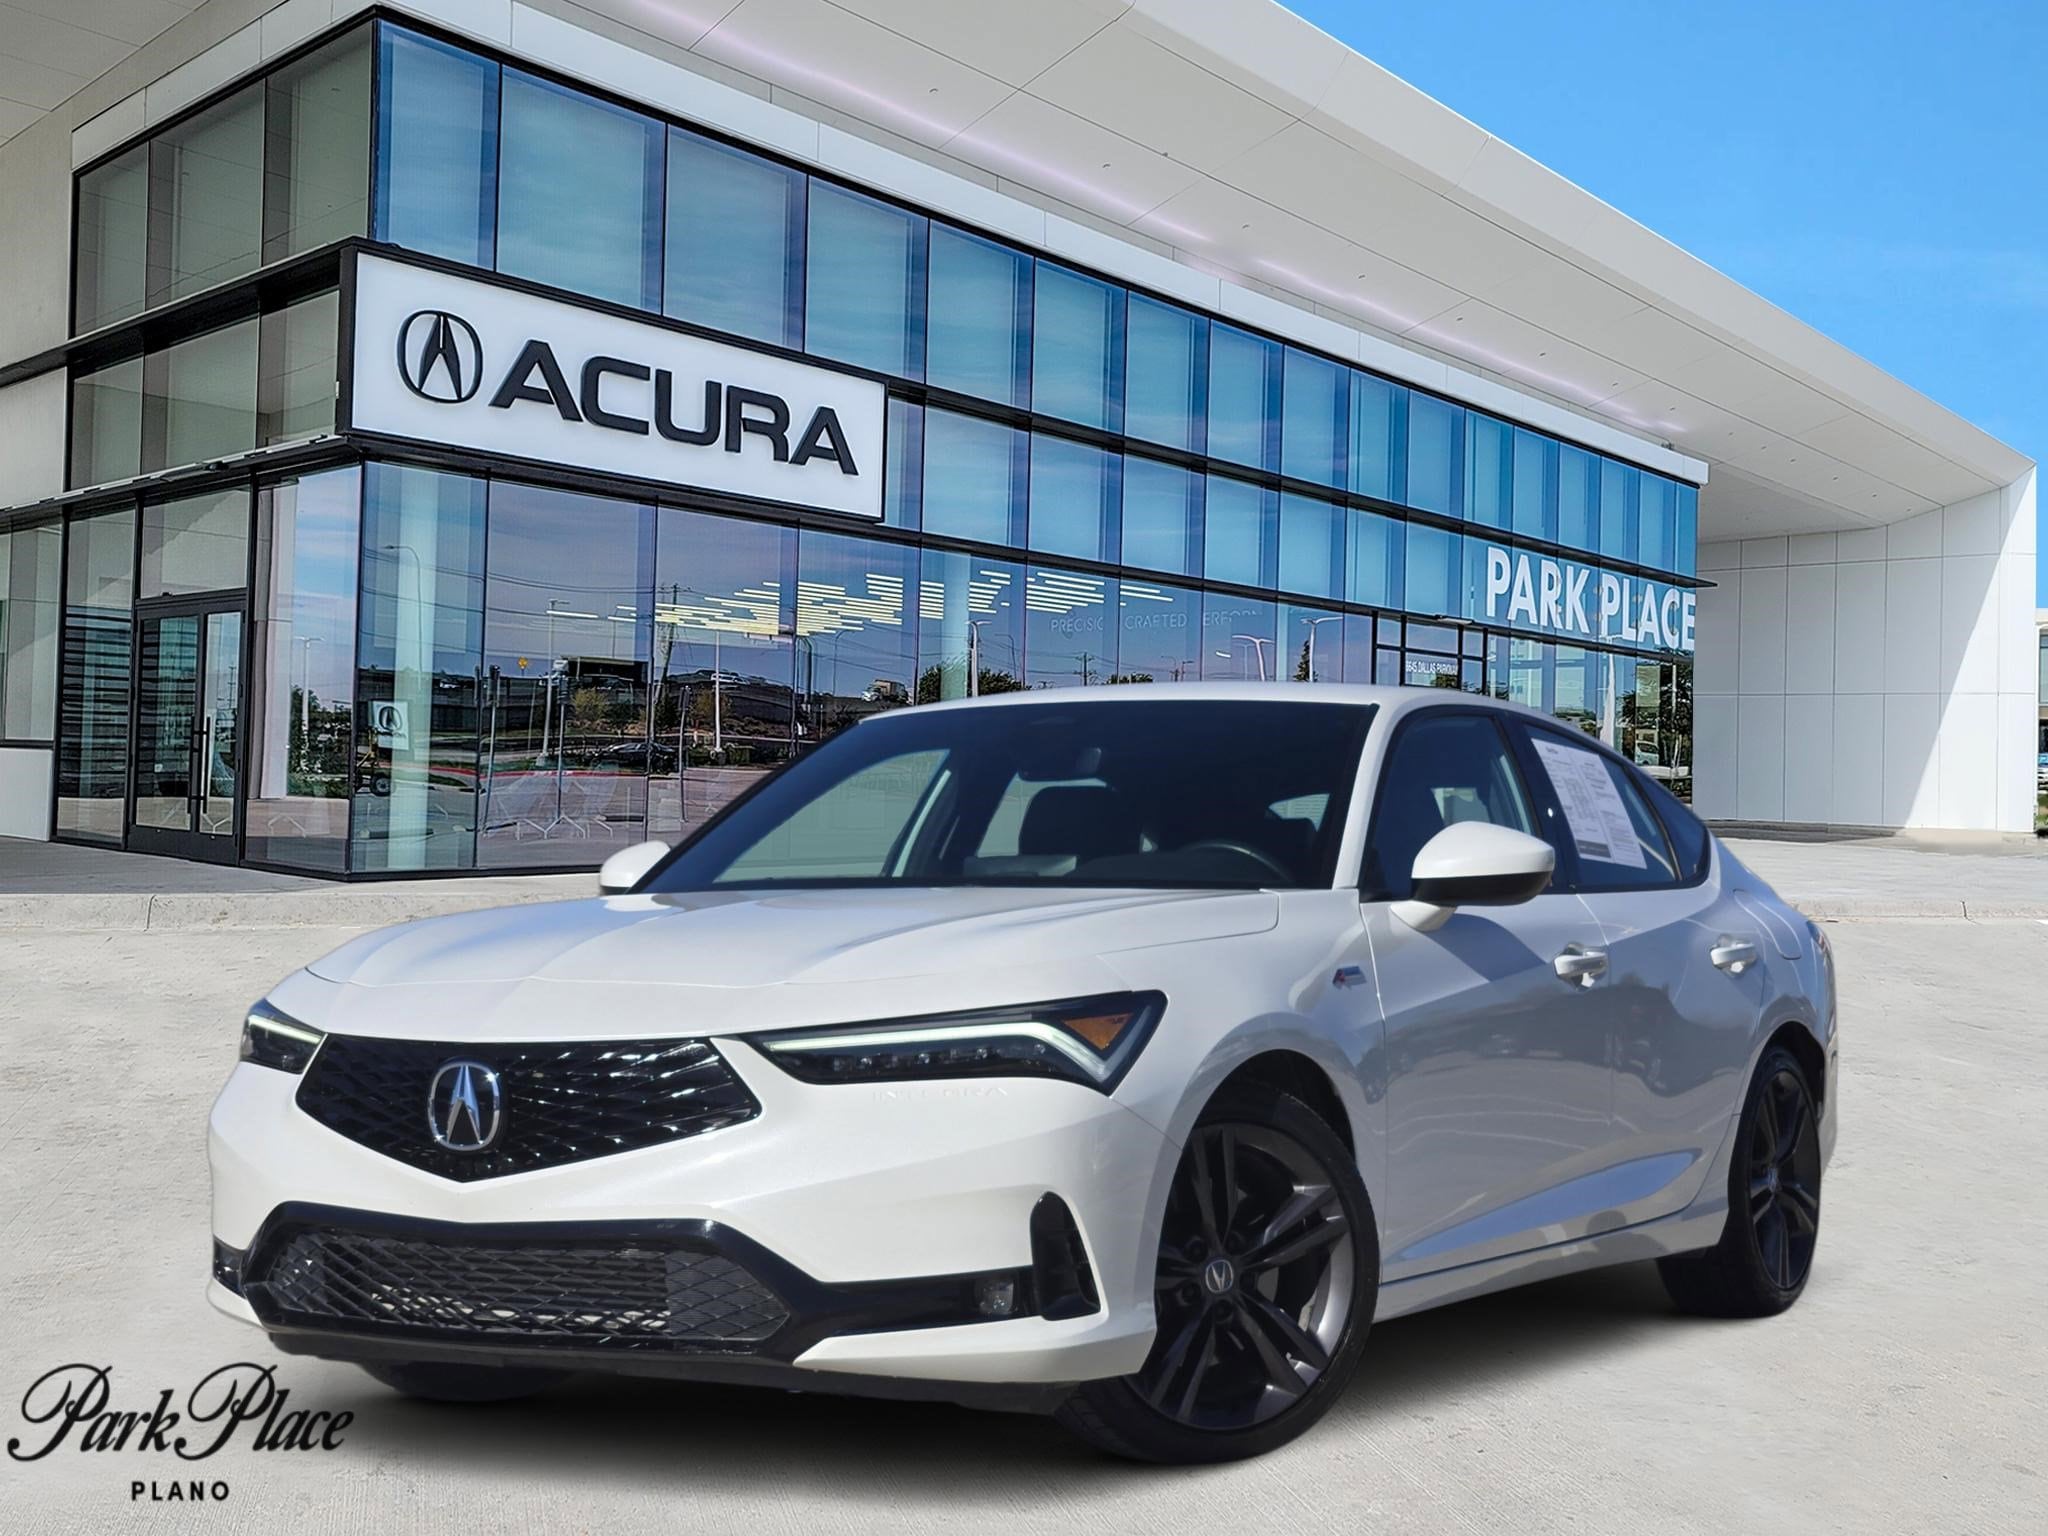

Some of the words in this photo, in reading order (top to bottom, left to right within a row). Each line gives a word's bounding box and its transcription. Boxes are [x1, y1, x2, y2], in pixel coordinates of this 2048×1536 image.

[487, 338, 859, 477] ACURA
[1051, 615, 1104, 633] PRECISIO
[1124, 613, 1188, 630] CRAFTED
[1486, 546, 1590, 634] PARK
[1600, 573, 1697, 651] PLACE
